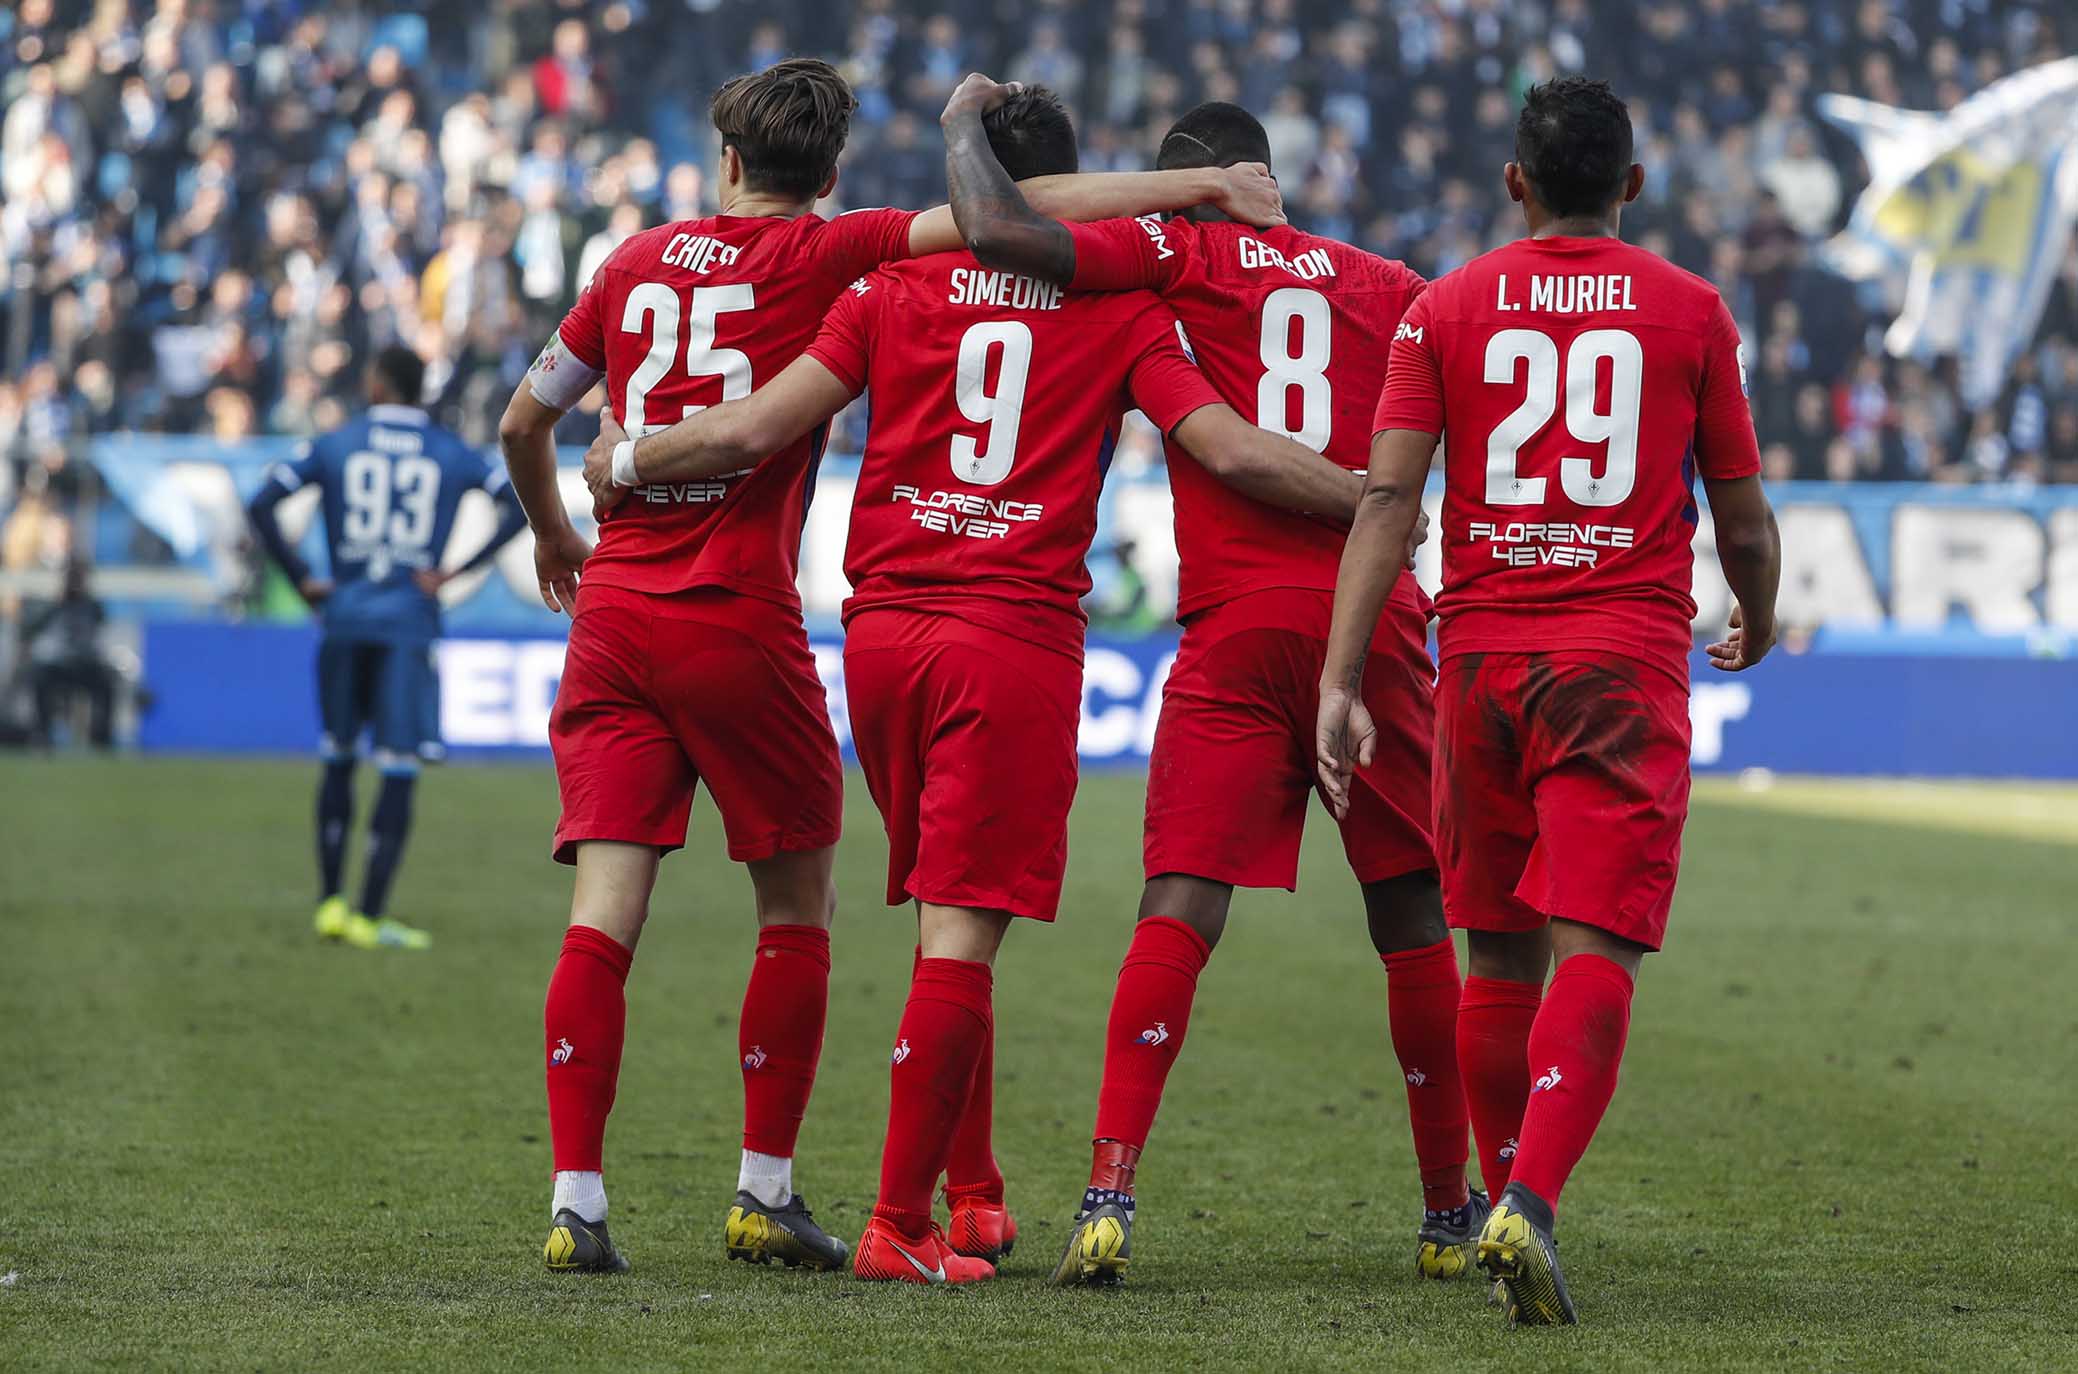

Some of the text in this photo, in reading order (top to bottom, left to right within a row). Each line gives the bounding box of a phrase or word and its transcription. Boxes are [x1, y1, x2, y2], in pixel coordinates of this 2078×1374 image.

[1496, 274, 1637, 314] L. MURIEL
[621, 282, 755, 442] 25
[1257, 287, 1332, 455] 8
[950, 320, 1033, 486] 9
[1483, 328, 1644, 507] 29
[344, 452, 441, 546] 93
[892, 485, 1044, 521] FLORENCE
[911, 509, 1010, 539] 4EVER
[1469, 522, 1634, 548] FLORENCE
[1492, 546, 1598, 568] 4EVER
